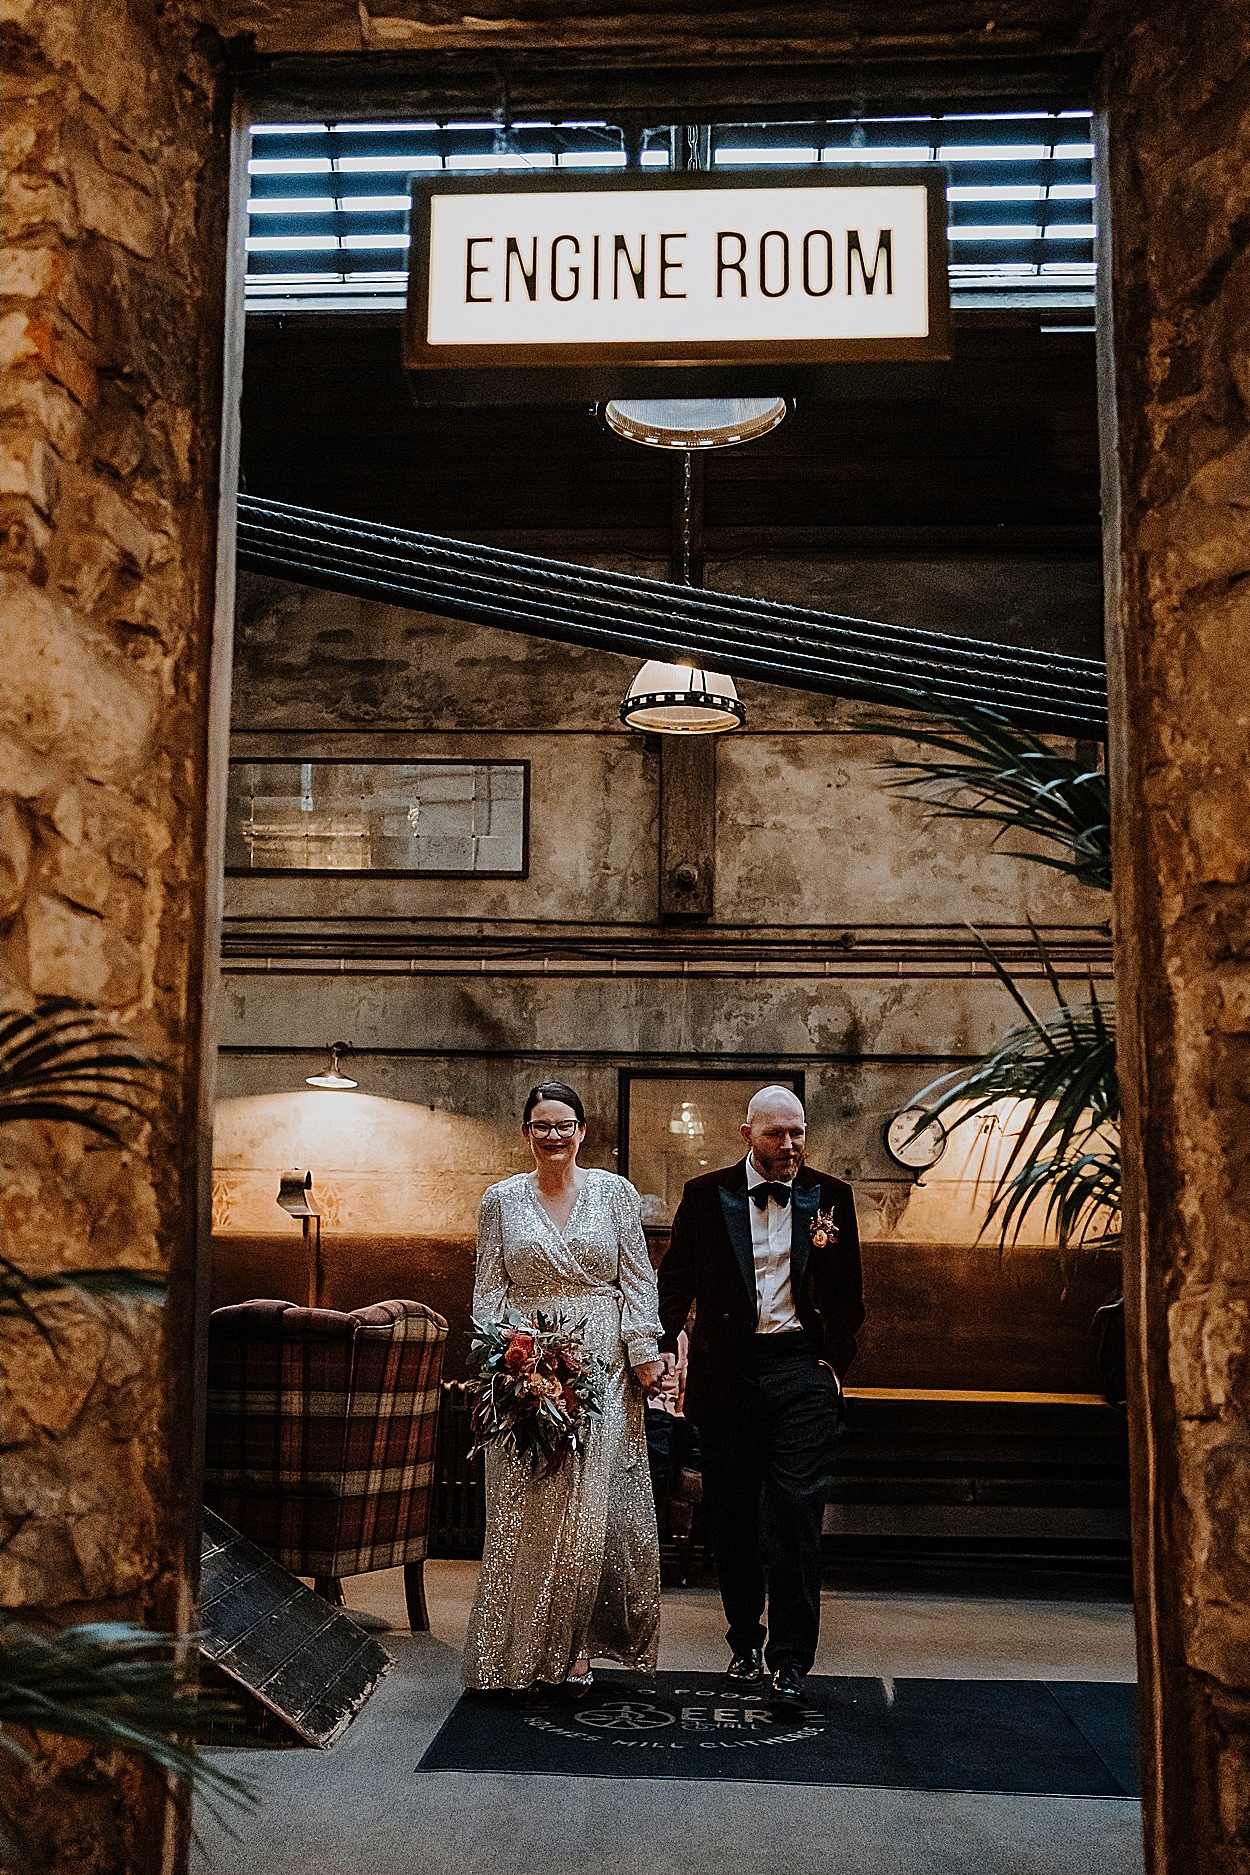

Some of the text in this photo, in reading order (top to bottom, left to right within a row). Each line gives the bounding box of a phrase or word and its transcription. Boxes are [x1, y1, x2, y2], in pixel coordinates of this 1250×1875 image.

[464, 229, 895, 304] ENGINE ROOM
[612, 1739, 684, 1749] MILL
